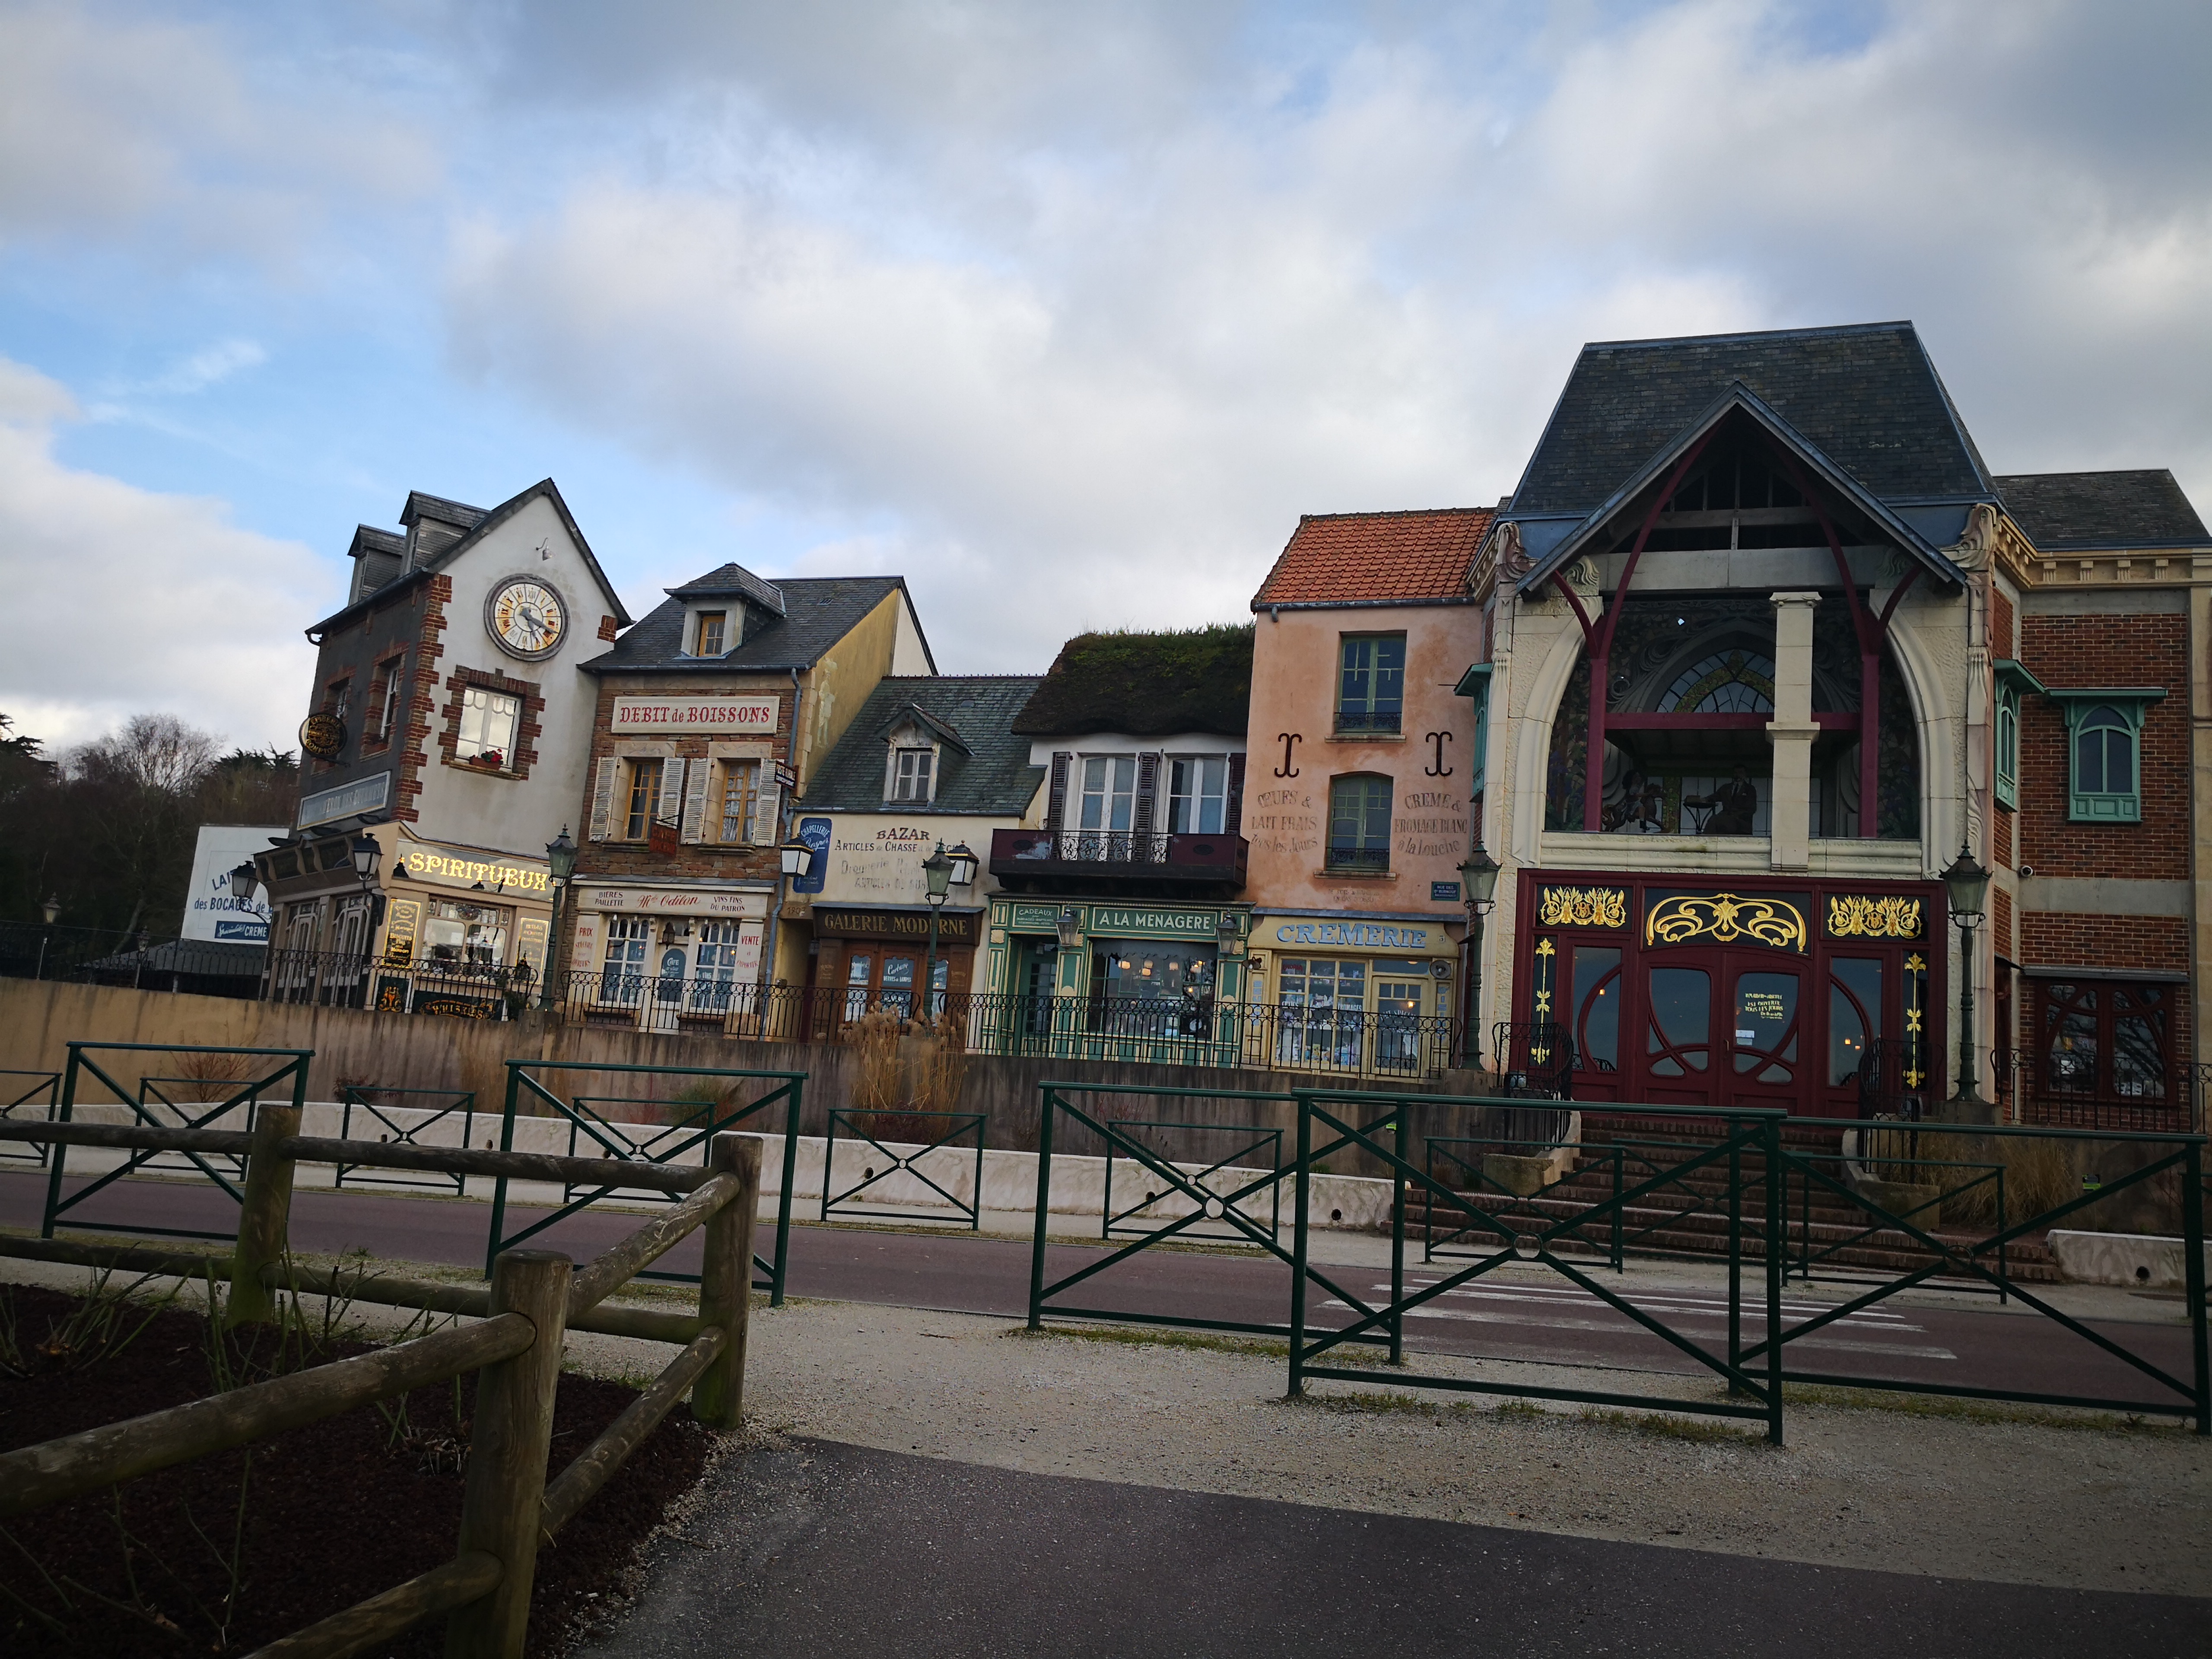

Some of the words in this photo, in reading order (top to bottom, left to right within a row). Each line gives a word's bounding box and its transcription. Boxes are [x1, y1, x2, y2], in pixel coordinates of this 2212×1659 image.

[620, 707, 670, 722] DEBIT
[672, 709, 684, 722] de
[687, 707, 770, 723] BOISSONS
[1301, 796, 1312, 809] &
[1452, 800, 1462, 812] &
[1251, 816, 1277, 830] LAIT
[1281, 816, 1317, 830] FRAIS
[1394, 818, 1438, 833] FROMAGE
[1439, 819, 1468, 833] BLANC
[801, 825, 830, 837] CHAPELLERIE
[876, 827, 930, 840] BAZAR
[1405, 838, 1417, 854] la
[409, 852, 548, 891] SPIRITUEUX
[194, 898, 208, 909] des
[256, 901, 265, 912] de
[661, 895, 701, 907] Odilon
[824, 914, 887, 932] GALERIE
[892, 917, 968, 936] MODRNE
[1099, 911, 1109, 925] A
[1114, 912, 1130, 926] LA
[1135, 913, 1210, 929] MENAGERE
[245, 925, 267, 937] CREME
[579, 927, 593, 937] PRIX
[1277, 923, 1427, 949] CREMERIE
[741, 935, 760, 946] VENTE
